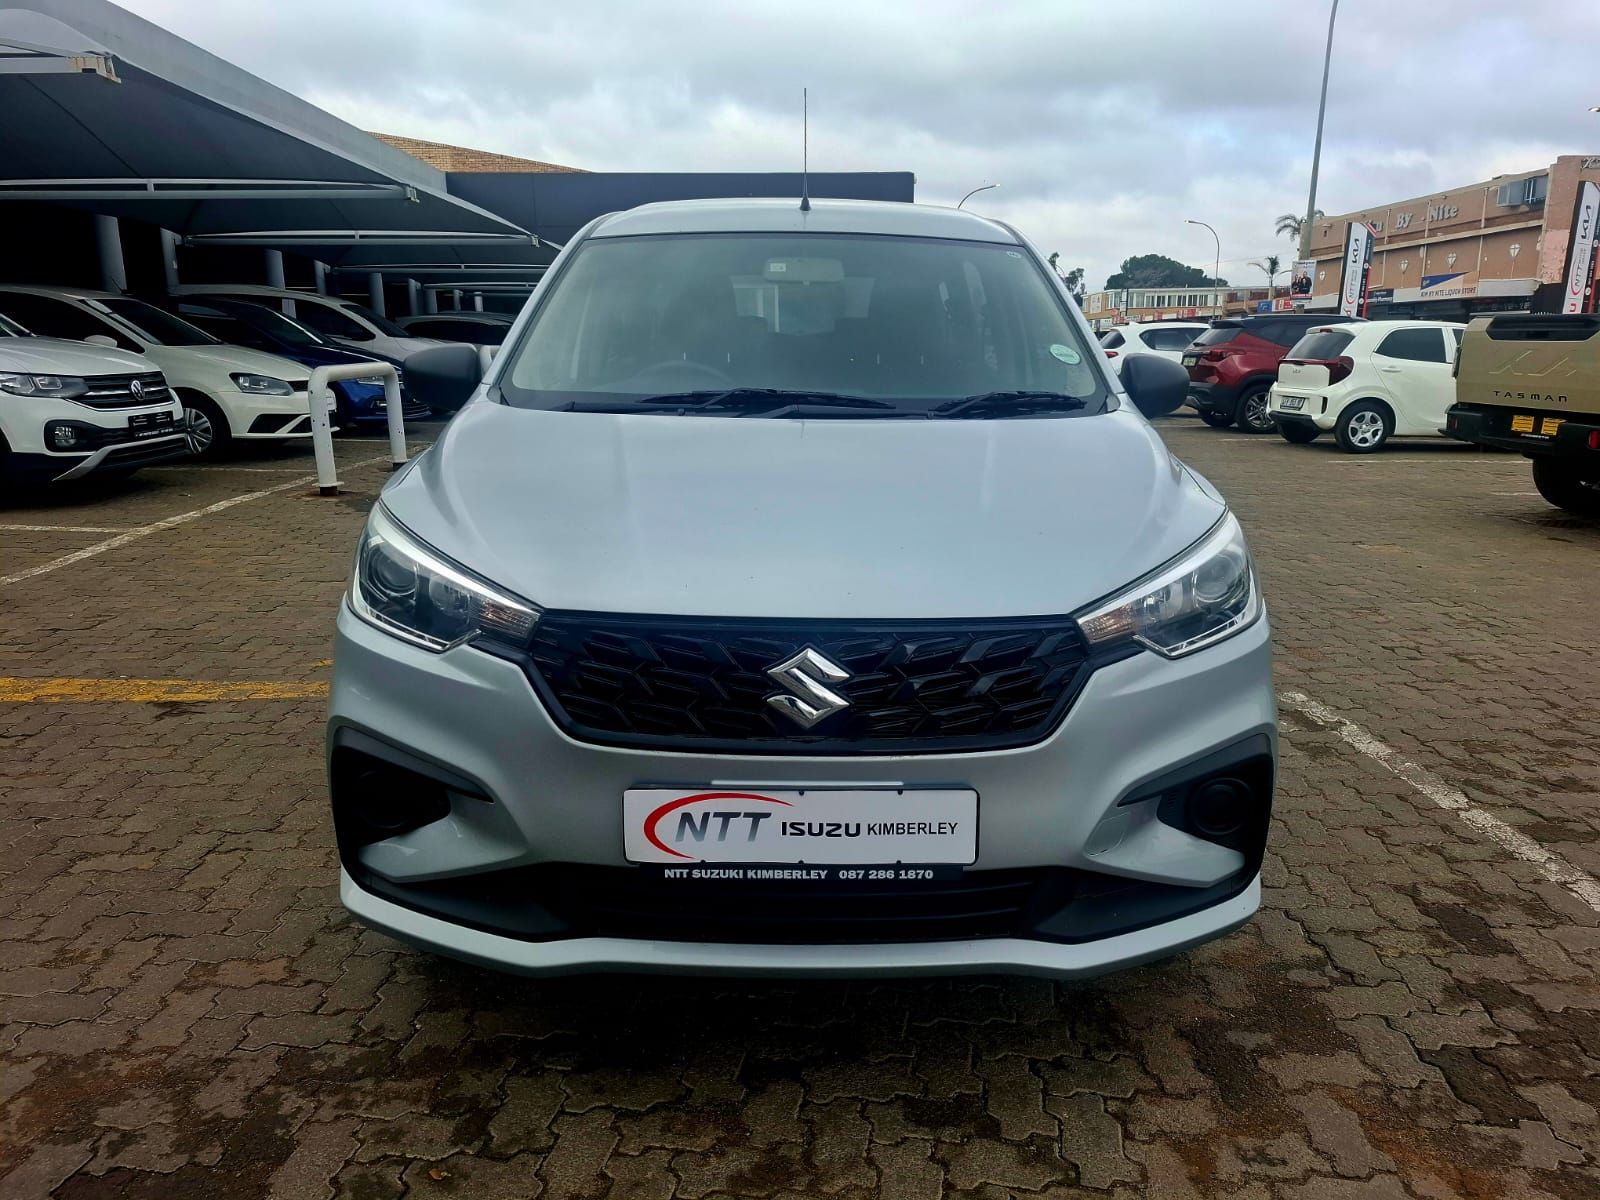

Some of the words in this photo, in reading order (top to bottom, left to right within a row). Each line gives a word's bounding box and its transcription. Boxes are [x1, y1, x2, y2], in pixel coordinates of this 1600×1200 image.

[1396, 212, 1413, 229] By
[1429, 205, 1459, 222] Nite
[1493, 390, 1568, 402] TASMAN
[675, 811, 772, 842] NTT
[781, 822, 862, 838] ISUZU
[867, 822, 958, 836] KIMBERLEY
[664, 869, 688, 879] NTT
[692, 869, 744, 879] SUZUKI
[747, 869, 828, 879] KIMBERLEY
[838, 869, 865, 879] 087
[868, 869, 895, 879] 286
[899, 869, 934, 879] 1870
